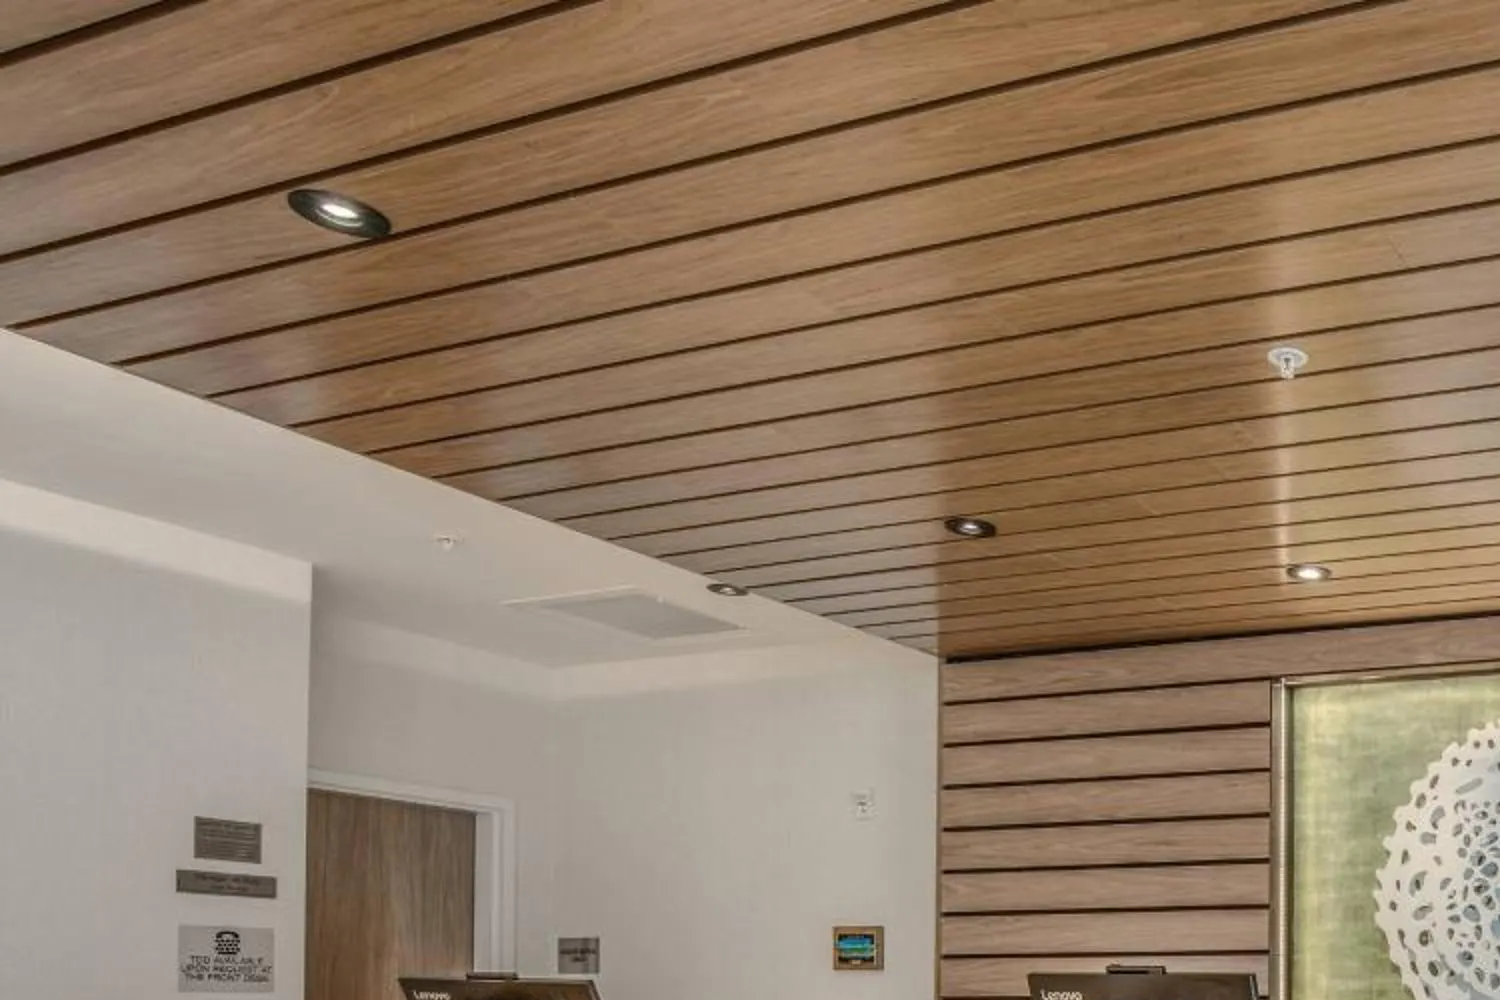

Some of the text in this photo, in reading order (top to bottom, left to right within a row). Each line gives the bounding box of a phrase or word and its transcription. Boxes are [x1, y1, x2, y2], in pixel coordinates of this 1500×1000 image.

[208, 974, 241, 983] FRONT
[412, 990, 451, 1000] Lenovo
[1040, 989, 1083, 1000] Lenovo
